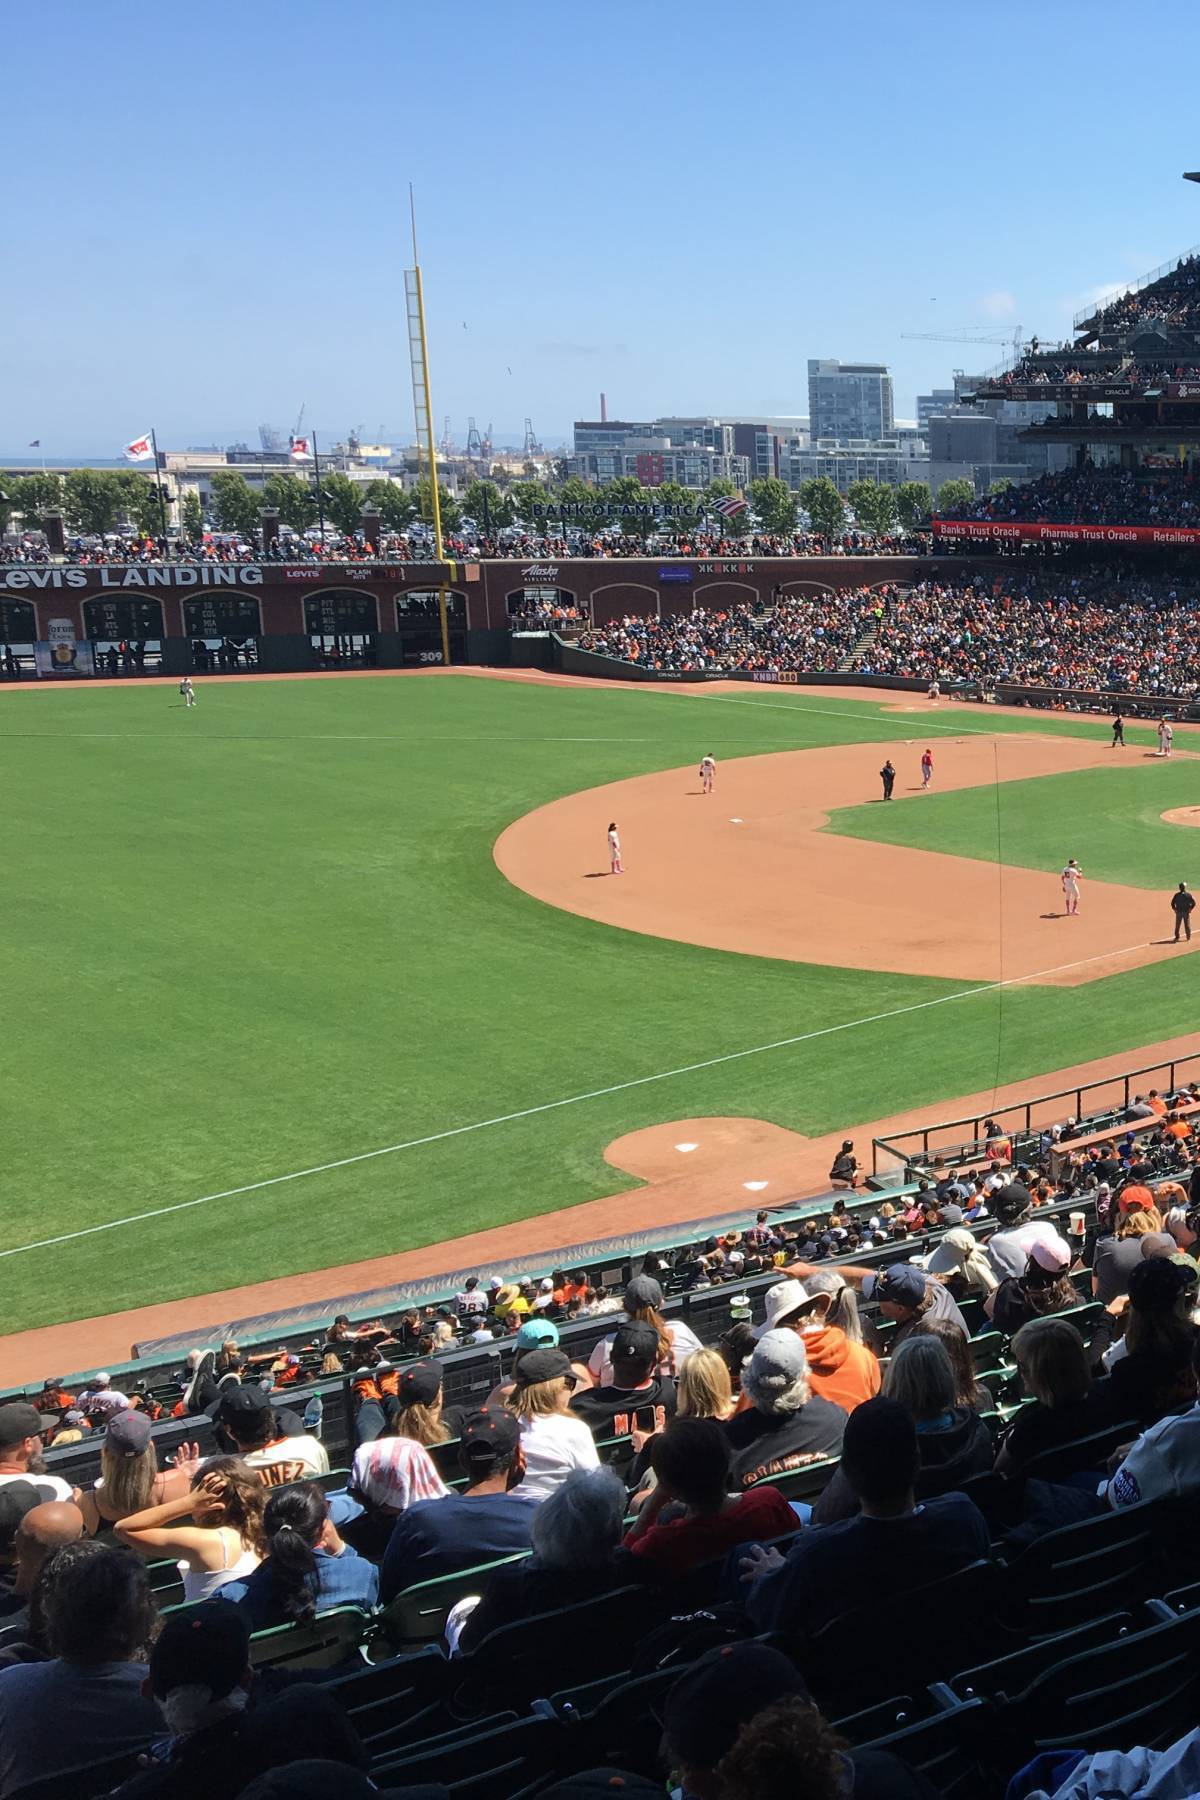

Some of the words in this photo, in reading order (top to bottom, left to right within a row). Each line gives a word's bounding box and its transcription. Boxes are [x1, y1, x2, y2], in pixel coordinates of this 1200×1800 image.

[533, 504, 586, 517] BANK
[592, 504, 617, 517] OF
[621, 504, 707, 517] AMERICA
[941, 525, 966, 536] Banks
[968, 526, 990, 537] Trust
[992, 527, 1021, 538] Oracle
[1040, 528, 1079, 540] Pharmas
[1081, 529, 1105, 541] Trust
[1107, 530, 1138, 541] Oracle
[1153, 531, 1196, 543] Retailers
[101, 566, 264, 588] LANDING
[521, 564, 559, 577] Alaska
[420, 651, 443, 662] 309
[753, 672, 778, 682] KNBR
[779, 672, 797, 682] 680
